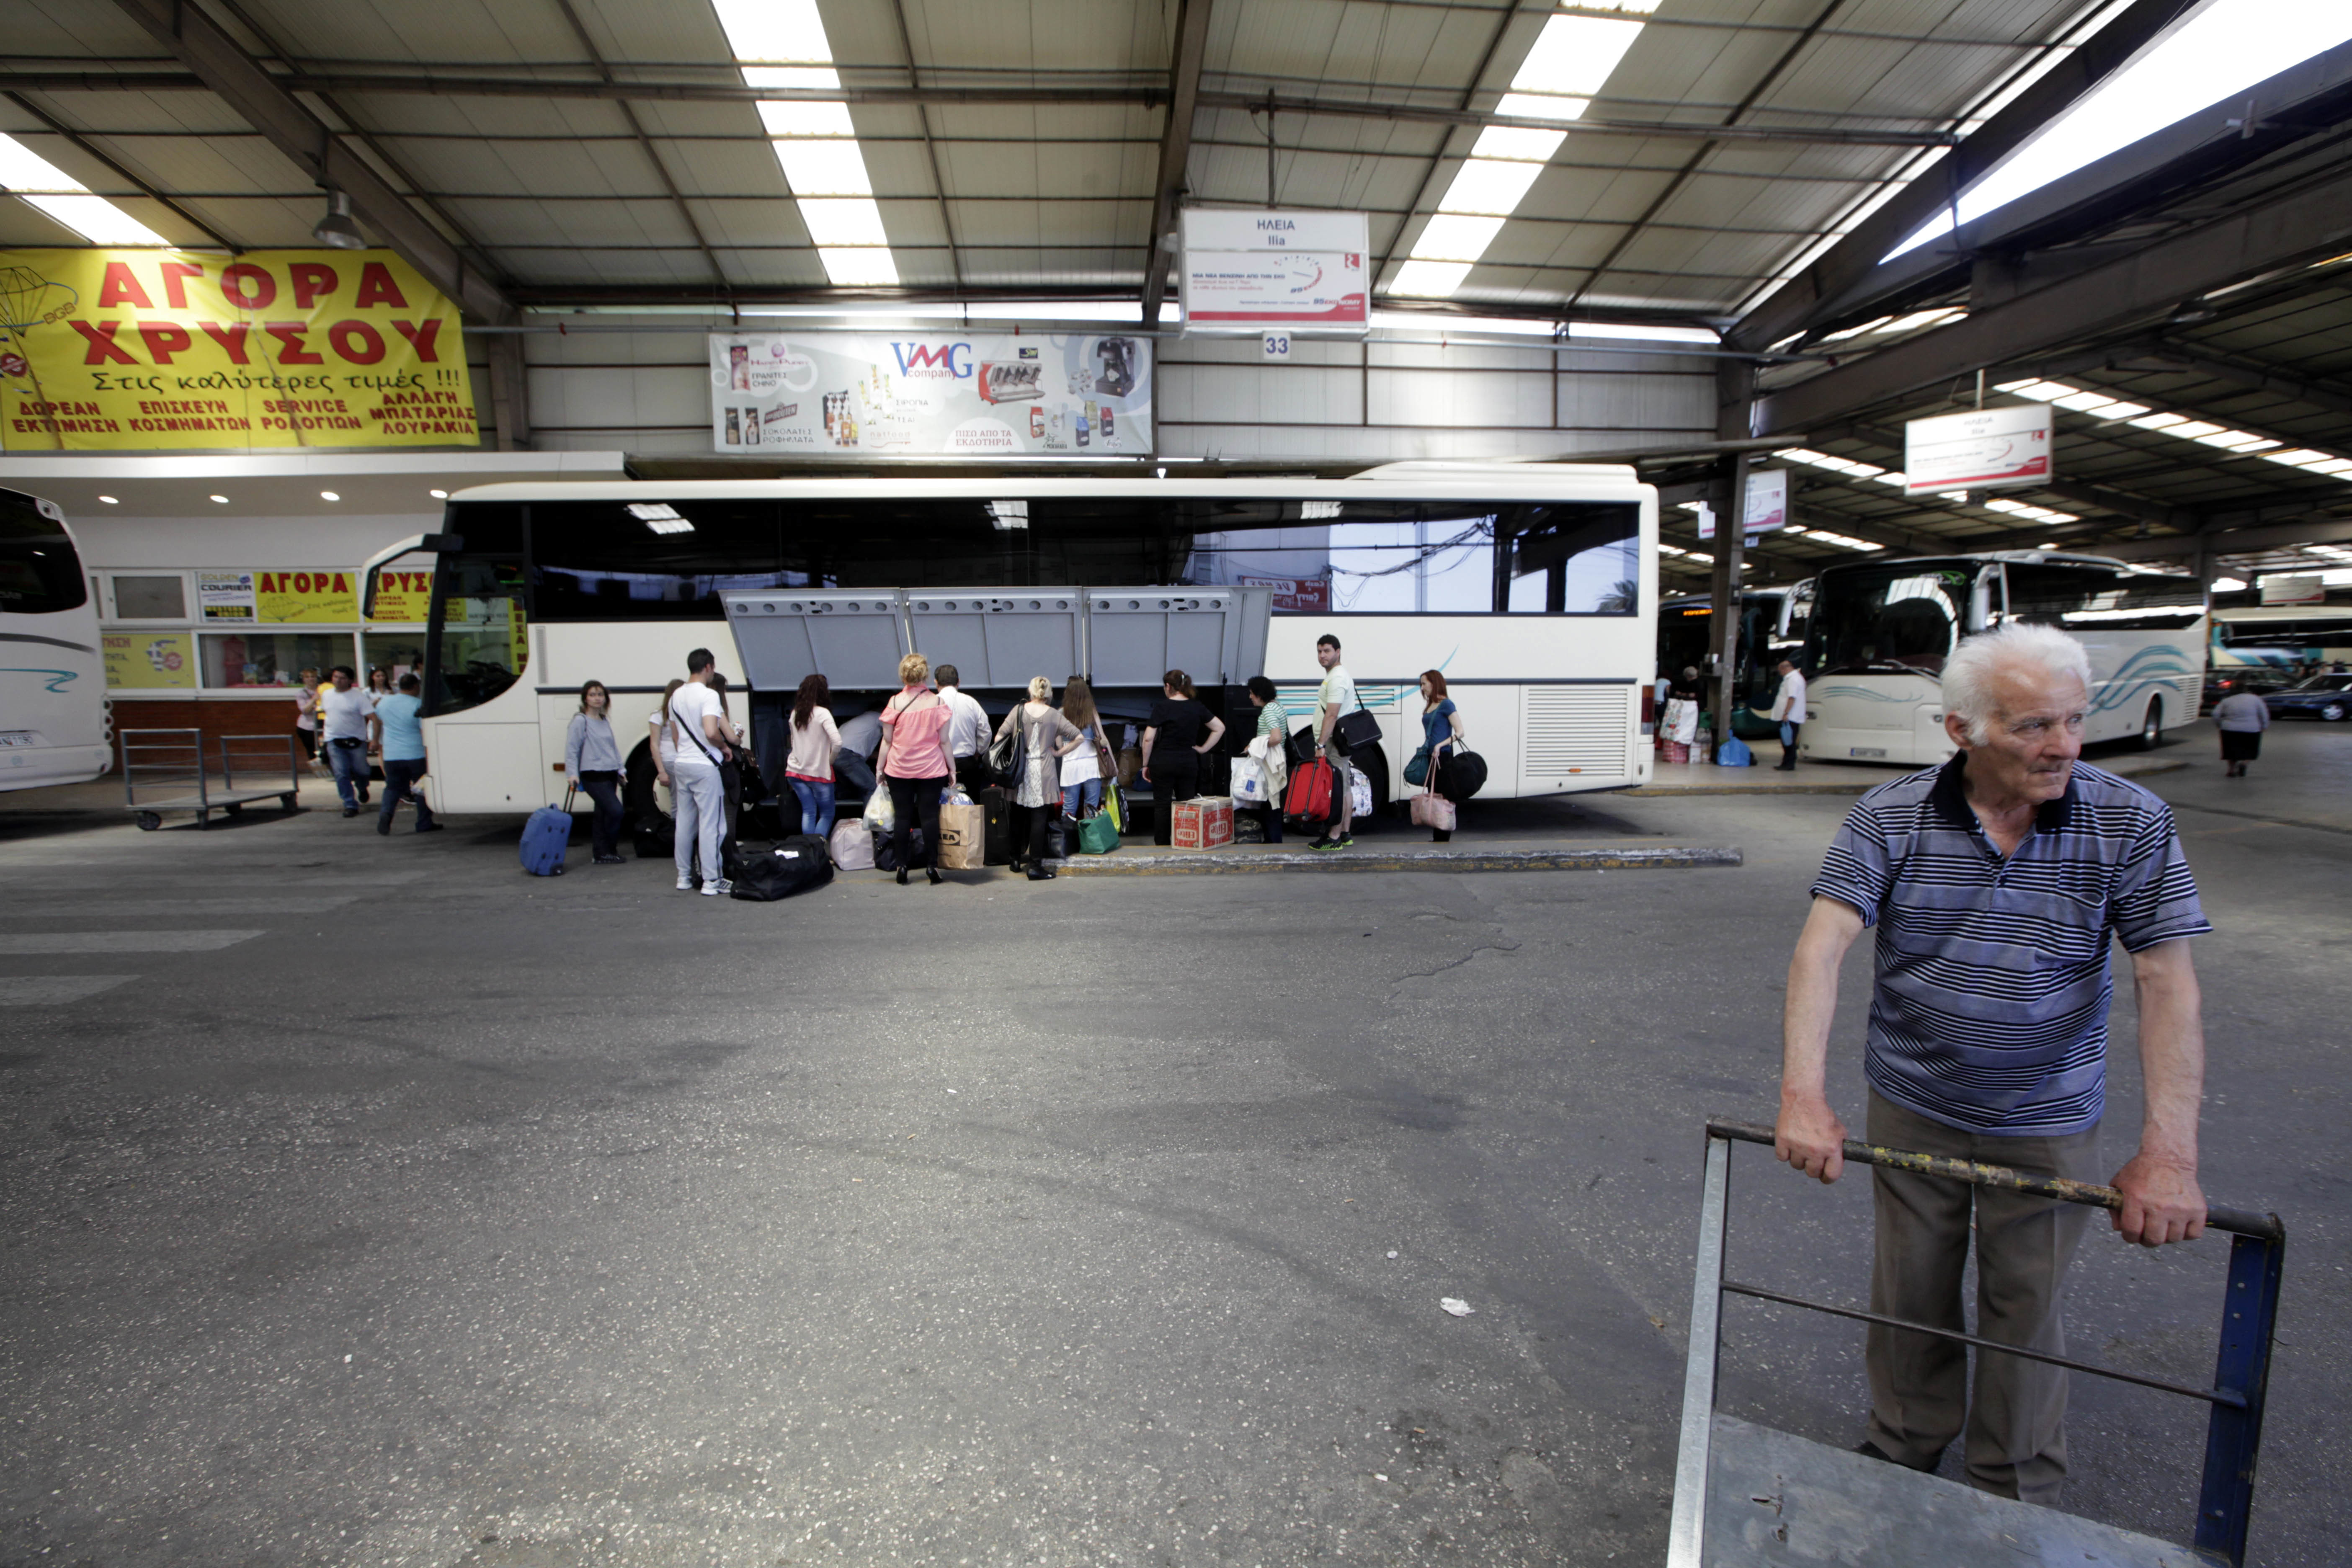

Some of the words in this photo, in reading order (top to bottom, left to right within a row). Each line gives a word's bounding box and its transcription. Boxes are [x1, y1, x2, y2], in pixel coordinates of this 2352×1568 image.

[1257, 219, 1295, 230] ΗΛΕΙΑ
[1269, 235, 1285, 246] Ilia
[98, 262, 409, 309] ΑΓΟΡΑ
[43, 302, 76, 325] BGB
[68, 319, 443, 365] ΧΡΥΣΟΥ
[1266, 337, 1288, 354] 33
[890, 343, 973, 378] VMG
[92, 372, 163, 394] Στις
[178, 369, 333, 393] καλύτερες
[343, 369, 426, 392] τιμές
[908, 370, 957, 380] company
[382, 391, 458, 405] ΑΛΛΑΓΗ
[20, 401, 101, 415] ΔΩΡΕΑΝ
[138, 400, 230, 415] ΕΠΙΣΚΕΥΗ
[263, 399, 348, 413] SERVICE
[369, 406, 476, 420] ΜΠΑΤΑΡΙΑΣ
[12, 418, 121, 433] ΕΚΤΙΜΗΣΗ
[128, 417, 253, 432] ΚΟΣΜΗΜΑΤΩΝ
[261, 416, 362, 430] ΡΟΛΟΓΙΩΝ
[383, 421, 474, 435] ΛΟΥΡΑΚΙΑ
[260, 573, 348, 593] ΑΓΟΡΑ
[377, 573, 434, 593] ΡΥΣ
